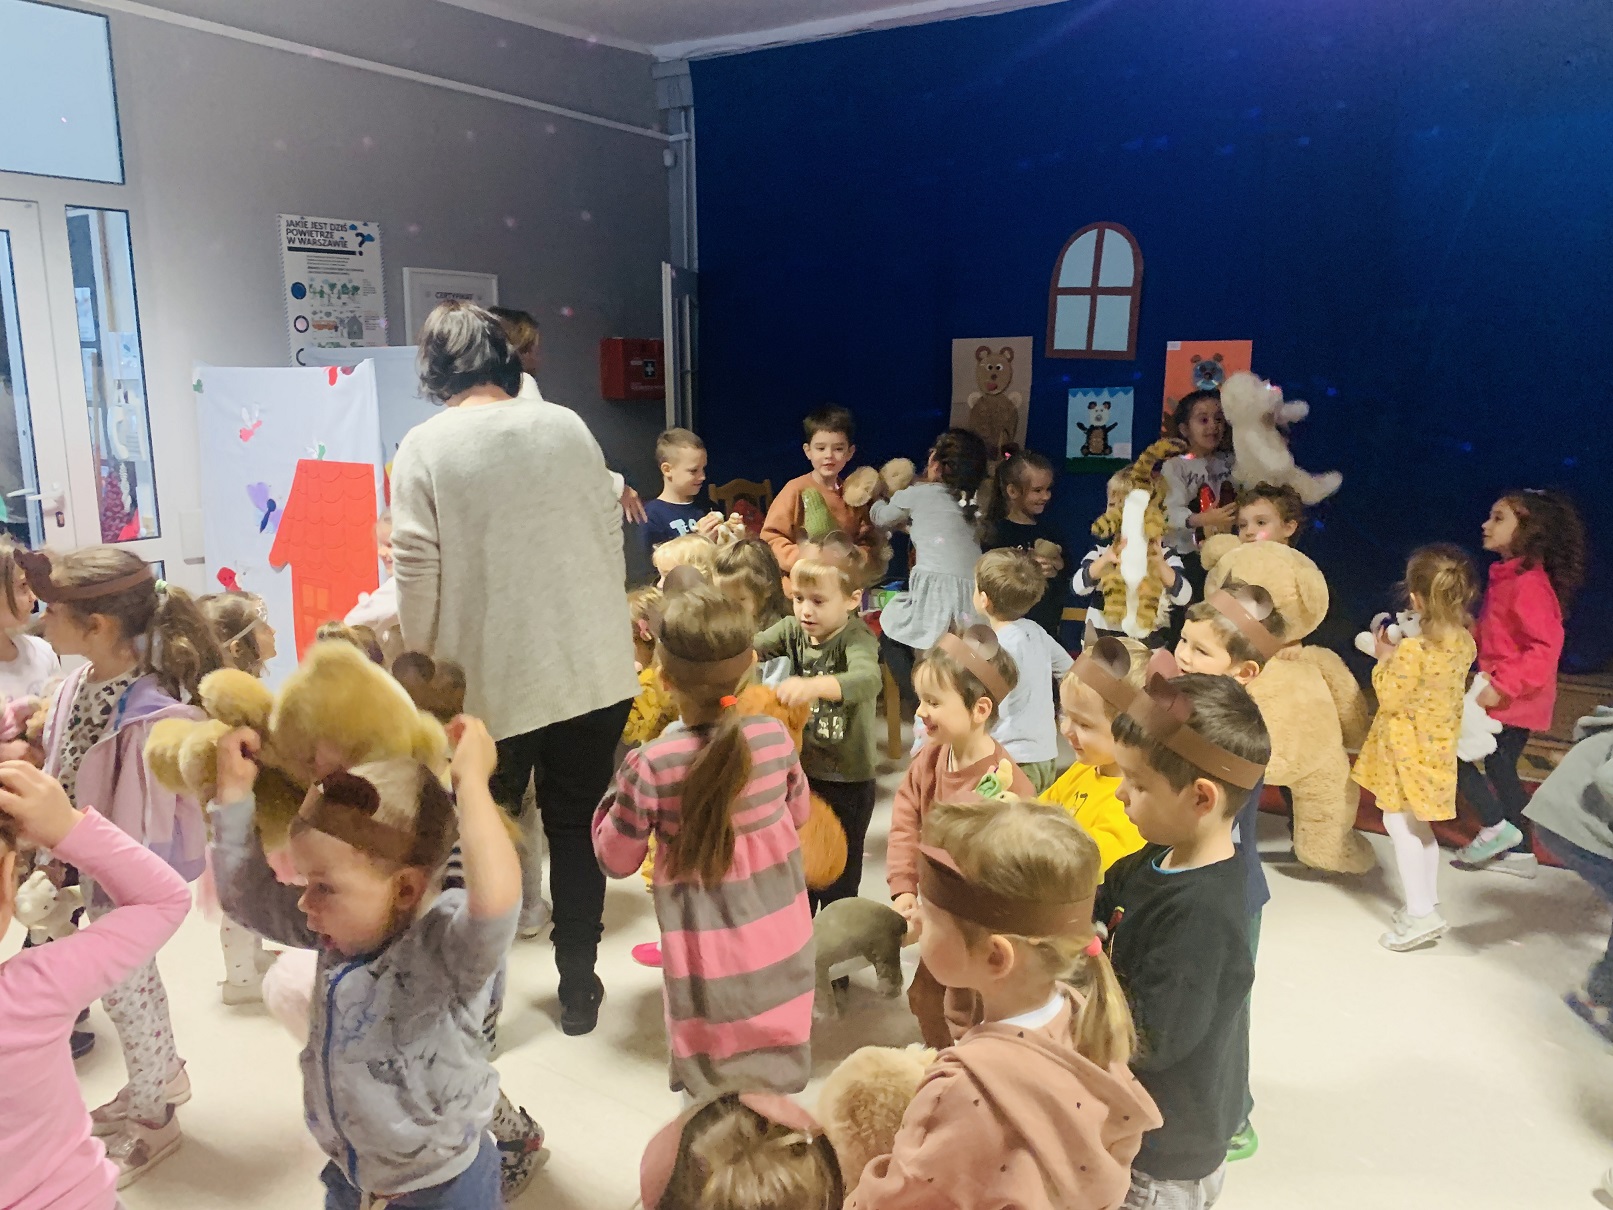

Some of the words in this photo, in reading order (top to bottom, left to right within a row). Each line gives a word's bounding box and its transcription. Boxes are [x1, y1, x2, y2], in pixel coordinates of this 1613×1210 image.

[286, 219, 308, 228] JAKIE
[310, 221, 328, 230] JEST
[330, 222, 348, 232] DZIŚ
[286, 228, 334, 239] POWIETRZE
[298, 237, 348, 248] WARSZAWIE
